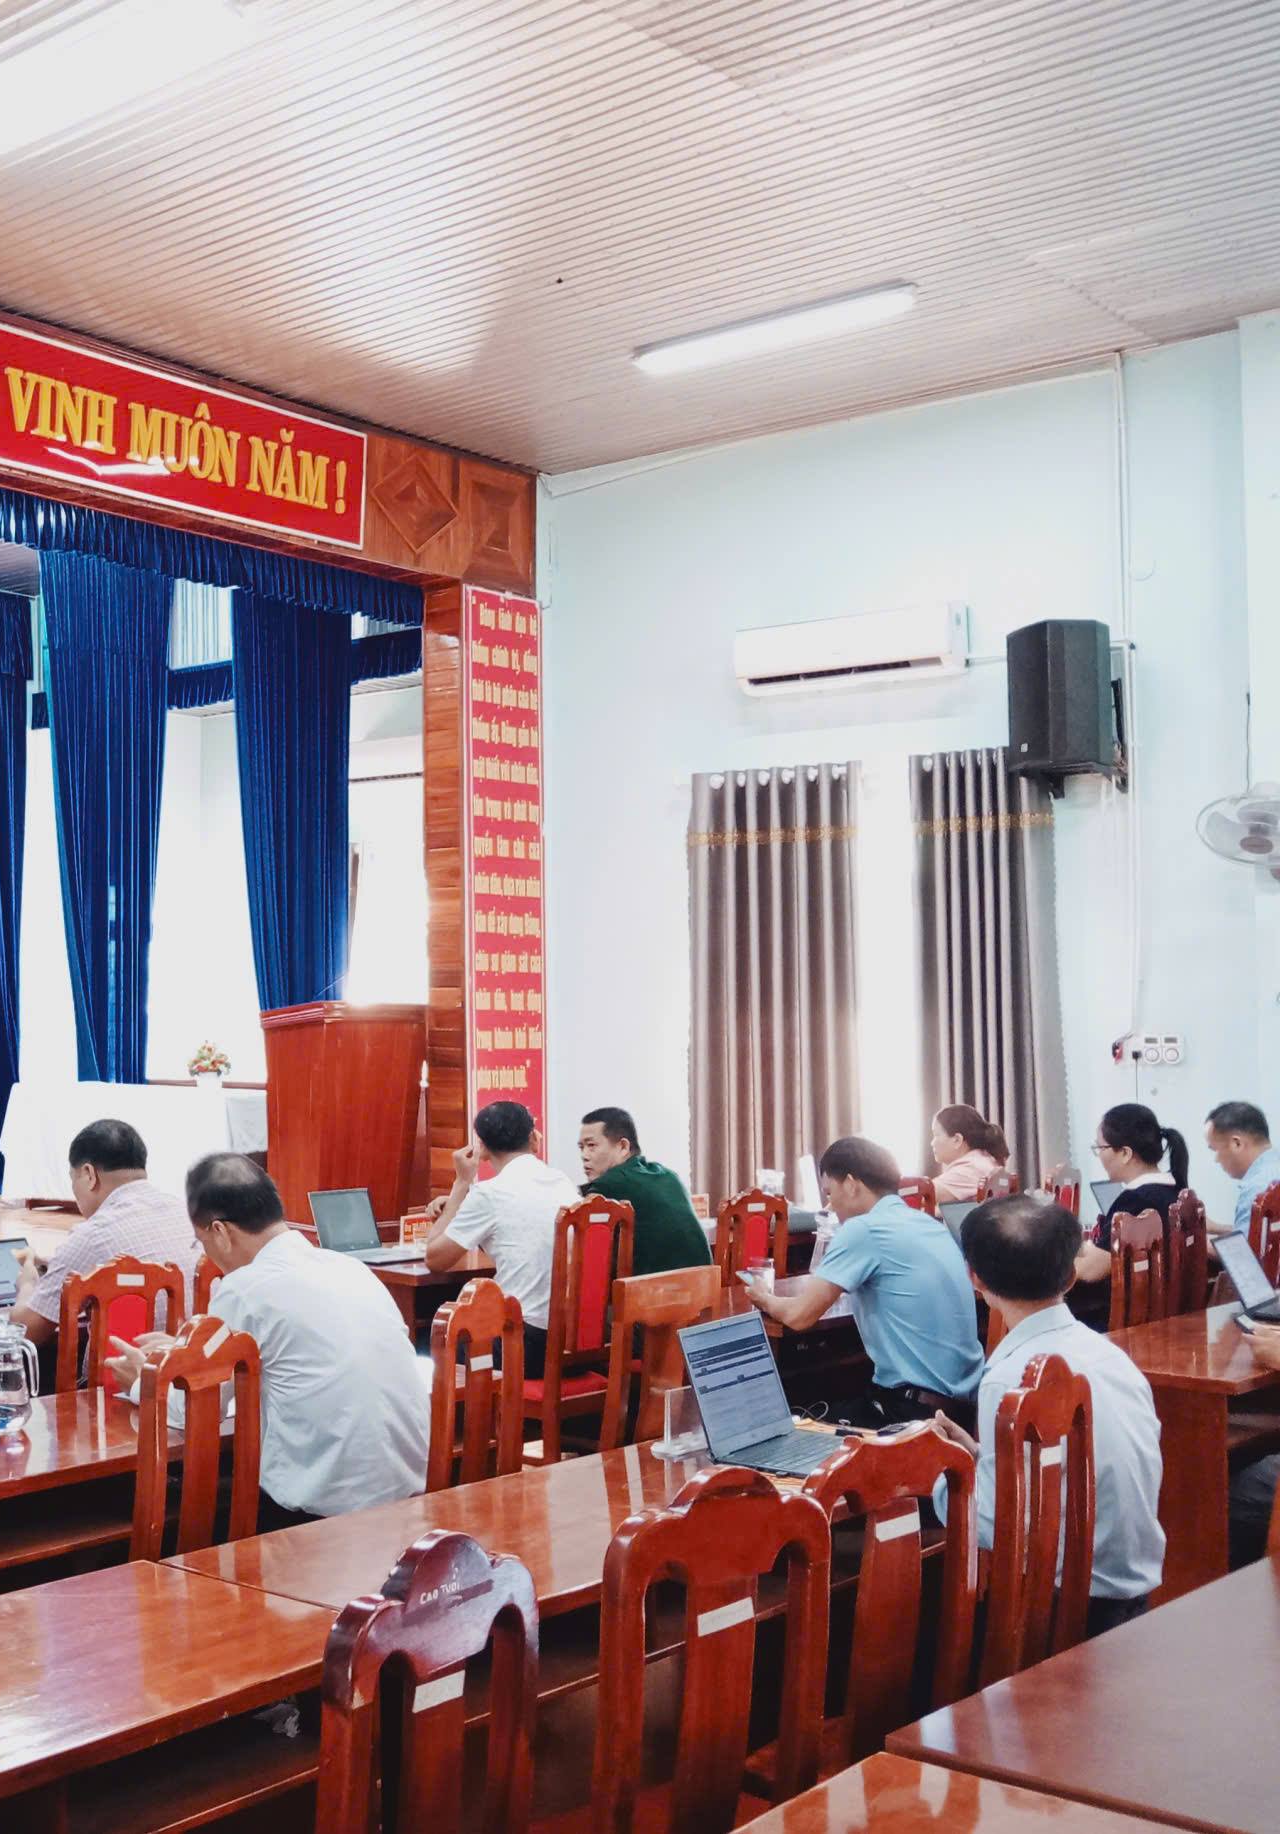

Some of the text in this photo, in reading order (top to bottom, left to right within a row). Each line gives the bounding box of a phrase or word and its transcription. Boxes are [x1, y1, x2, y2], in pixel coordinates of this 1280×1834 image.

[5, 367, 117, 454] VINH
[127, 403, 241, 487] MUÔN
[248, 427, 327, 509] NĂM
